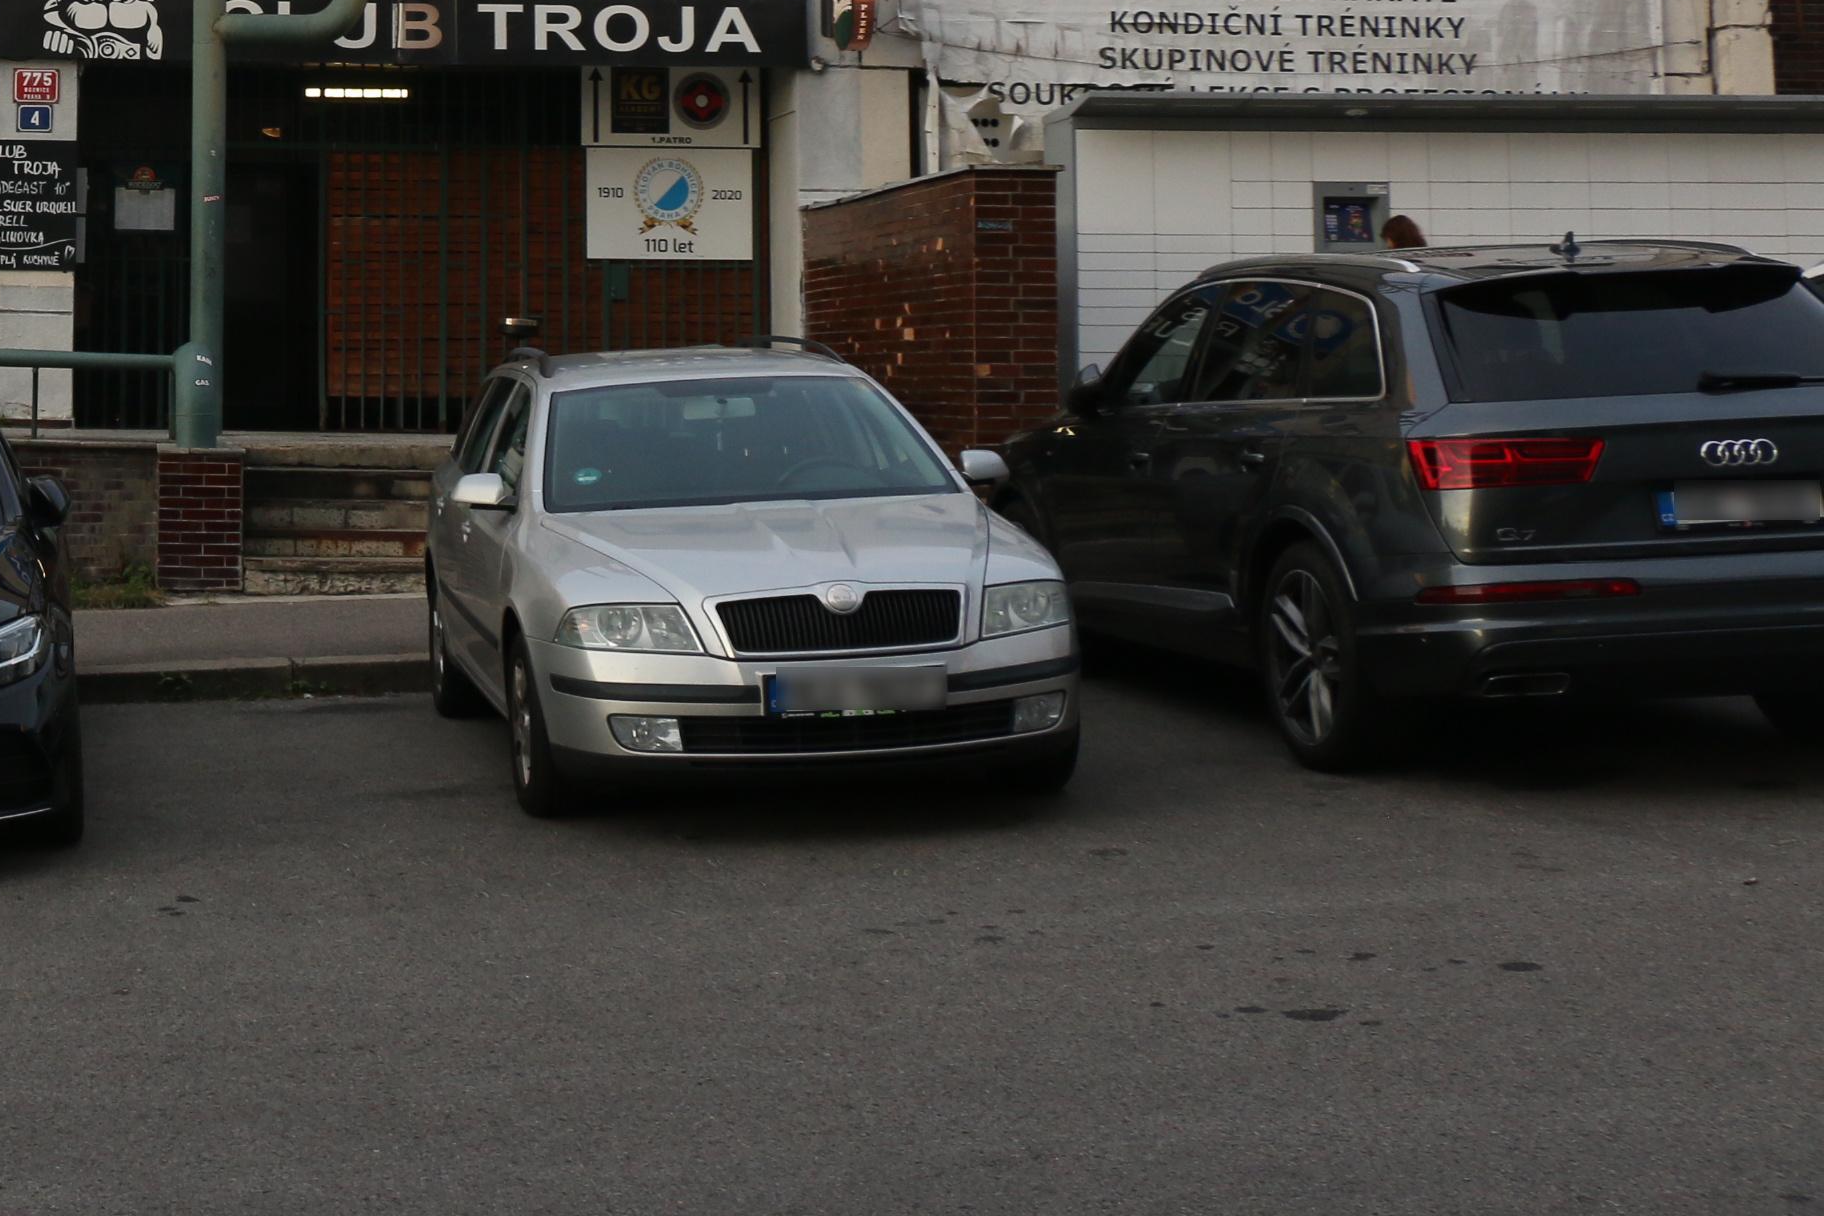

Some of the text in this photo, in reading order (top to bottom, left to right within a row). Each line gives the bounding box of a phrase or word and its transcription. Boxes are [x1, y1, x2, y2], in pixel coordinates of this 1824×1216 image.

[226, 0, 762, 53] UB TROJA
[1110, 5, 1466, 39] KONDIČNÍ TRÉNINKY
[1098, 42, 1478, 75] SKUPINOVÉ TRÉNINKY
[23, 72, 52, 86] 775
[620, 75, 662, 101] KG
[30, 110, 40, 126] 4
[12, 160, 62, 179] TROJA
[640, 162, 697, 194] SLOVAN BOHNICE
[598, 187, 624, 198] 1910
[712, 189, 742, 200] 2020
[36, 201, 77, 214] URQUELL
[647, 205, 681, 218] PRAHA
[644, 238, 694, 253] 110 let
